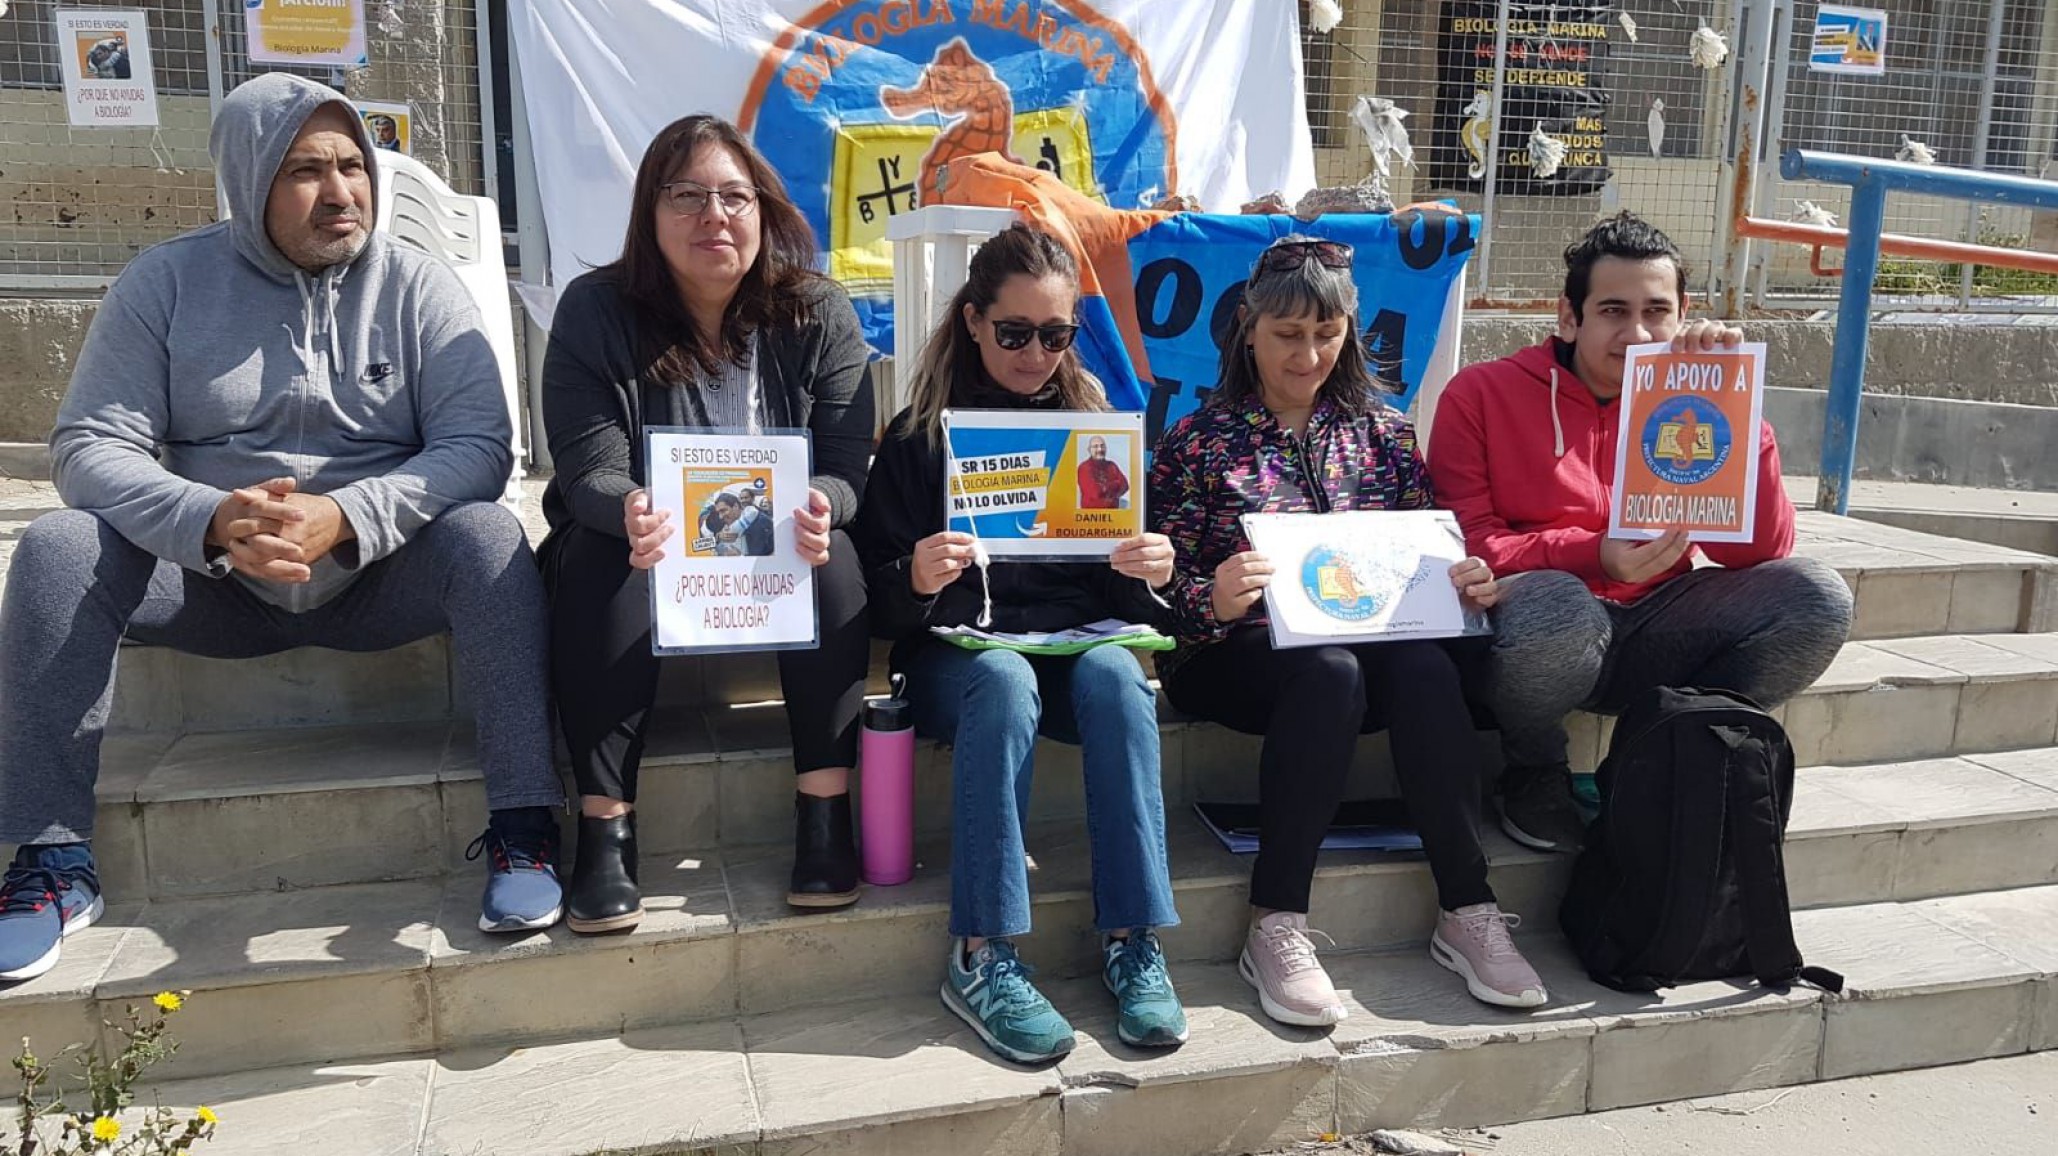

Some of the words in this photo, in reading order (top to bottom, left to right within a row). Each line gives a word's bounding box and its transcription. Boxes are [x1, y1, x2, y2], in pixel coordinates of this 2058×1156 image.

[1454, 18, 1538, 34] BIOLGIA
[1547, 21, 1607, 38] MARINA
[968, 0, 1115, 84] MARINA
[1474, 70, 1495, 83] SE
[1507, 71, 1587, 87] DEFIENDE
[1575, 116, 1602, 131] MAS
[887, 154, 900, 180] Y
[1509, 151, 1532, 166] QU
[1562, 152, 1603, 166] UNCA
[858, 200, 875, 224] B
[1635, 363, 1655, 392] YO
[1664, 361, 1723, 392] APOYO
[1733, 363, 1747, 392] A
[670, 447, 682, 463] SI
[684, 447, 714, 463] ESTO
[716, 448, 732, 464] ES
[733, 448, 778, 464] VERDAD
[961, 460, 979, 474] SR
[982, 458, 998, 472] 15
[1000, 456, 1031, 470] DIAS
[1001, 473, 1040, 487] MARINA
[975, 495, 990, 508] LO
[992, 490, 1037, 506] OLVIDA
[1075, 513, 1113, 523] DANIEL
[1685, 495, 1736, 527] MARINA
[1055, 528, 1133, 538] BOUDARGHAM
[675, 574, 706, 604] ¿POR
[708, 574, 732, 597] QUE
[734, 573, 751, 597] NO
[752, 572, 795, 597] AYUDAS
[703, 607, 712, 629] A
